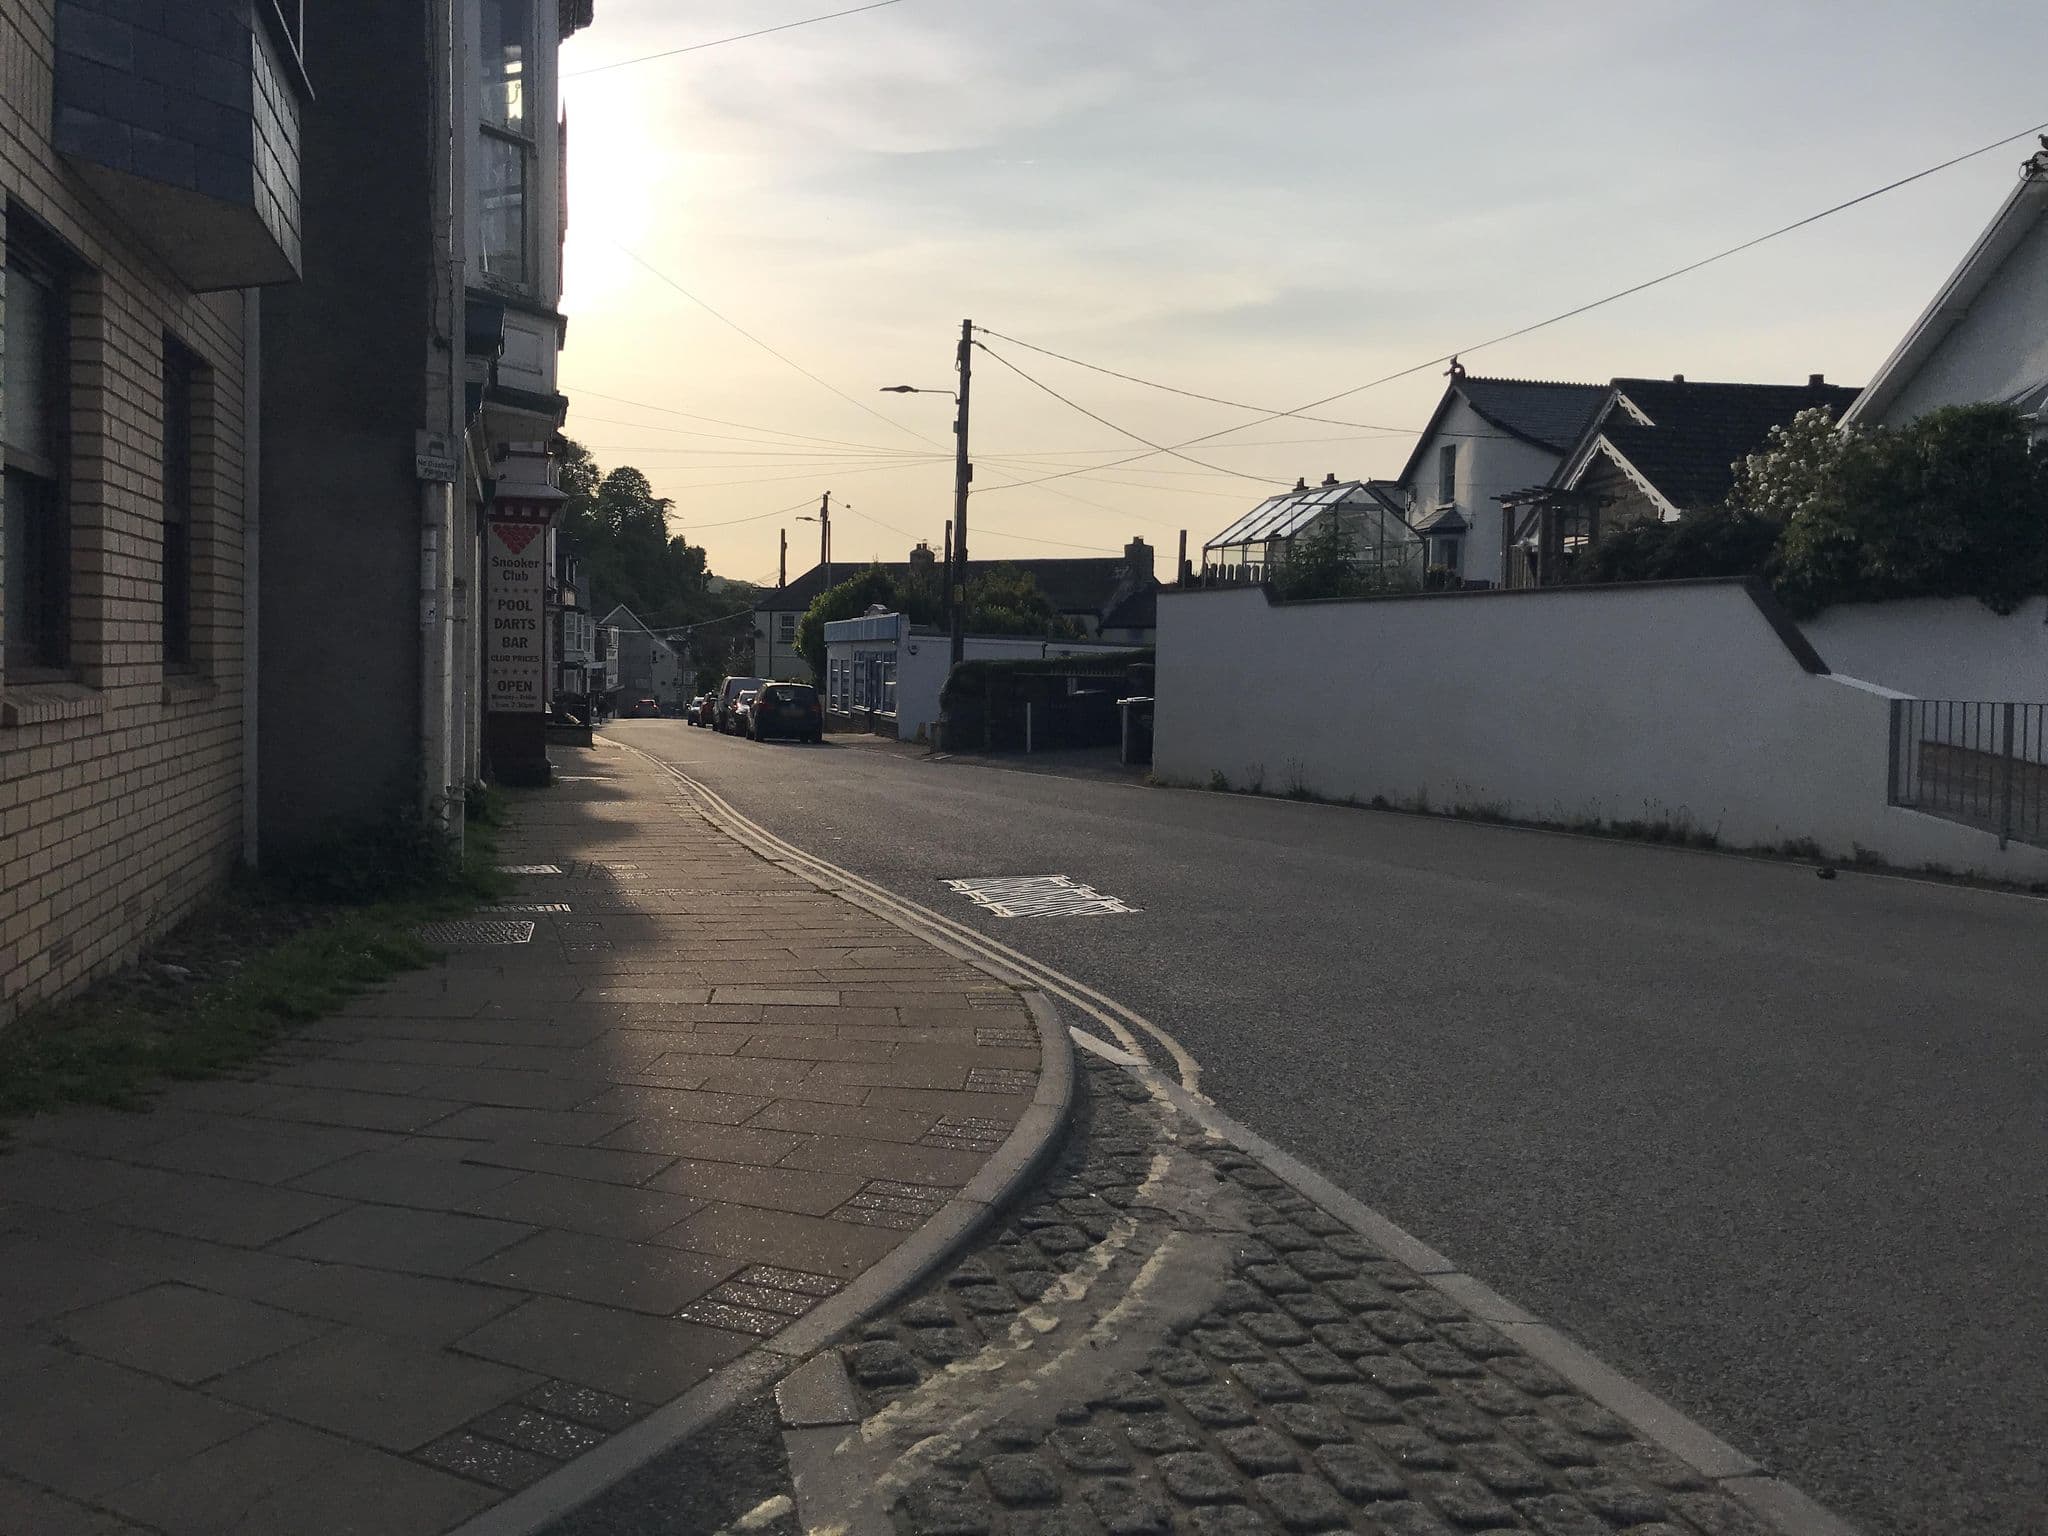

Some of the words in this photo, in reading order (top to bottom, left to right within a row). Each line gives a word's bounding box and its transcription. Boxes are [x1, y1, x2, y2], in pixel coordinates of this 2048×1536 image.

[492, 555, 540, 568] Snooker
[503, 570, 528, 582] Club
[498, 600, 533, 611] POOL
[494, 617, 536, 630] DARTS
[502, 637, 528, 649] BAR
[491, 655, 511, 663] CLUB
[513, 655, 539, 663] PRICES
[497, 680, 533, 692] OPEN
